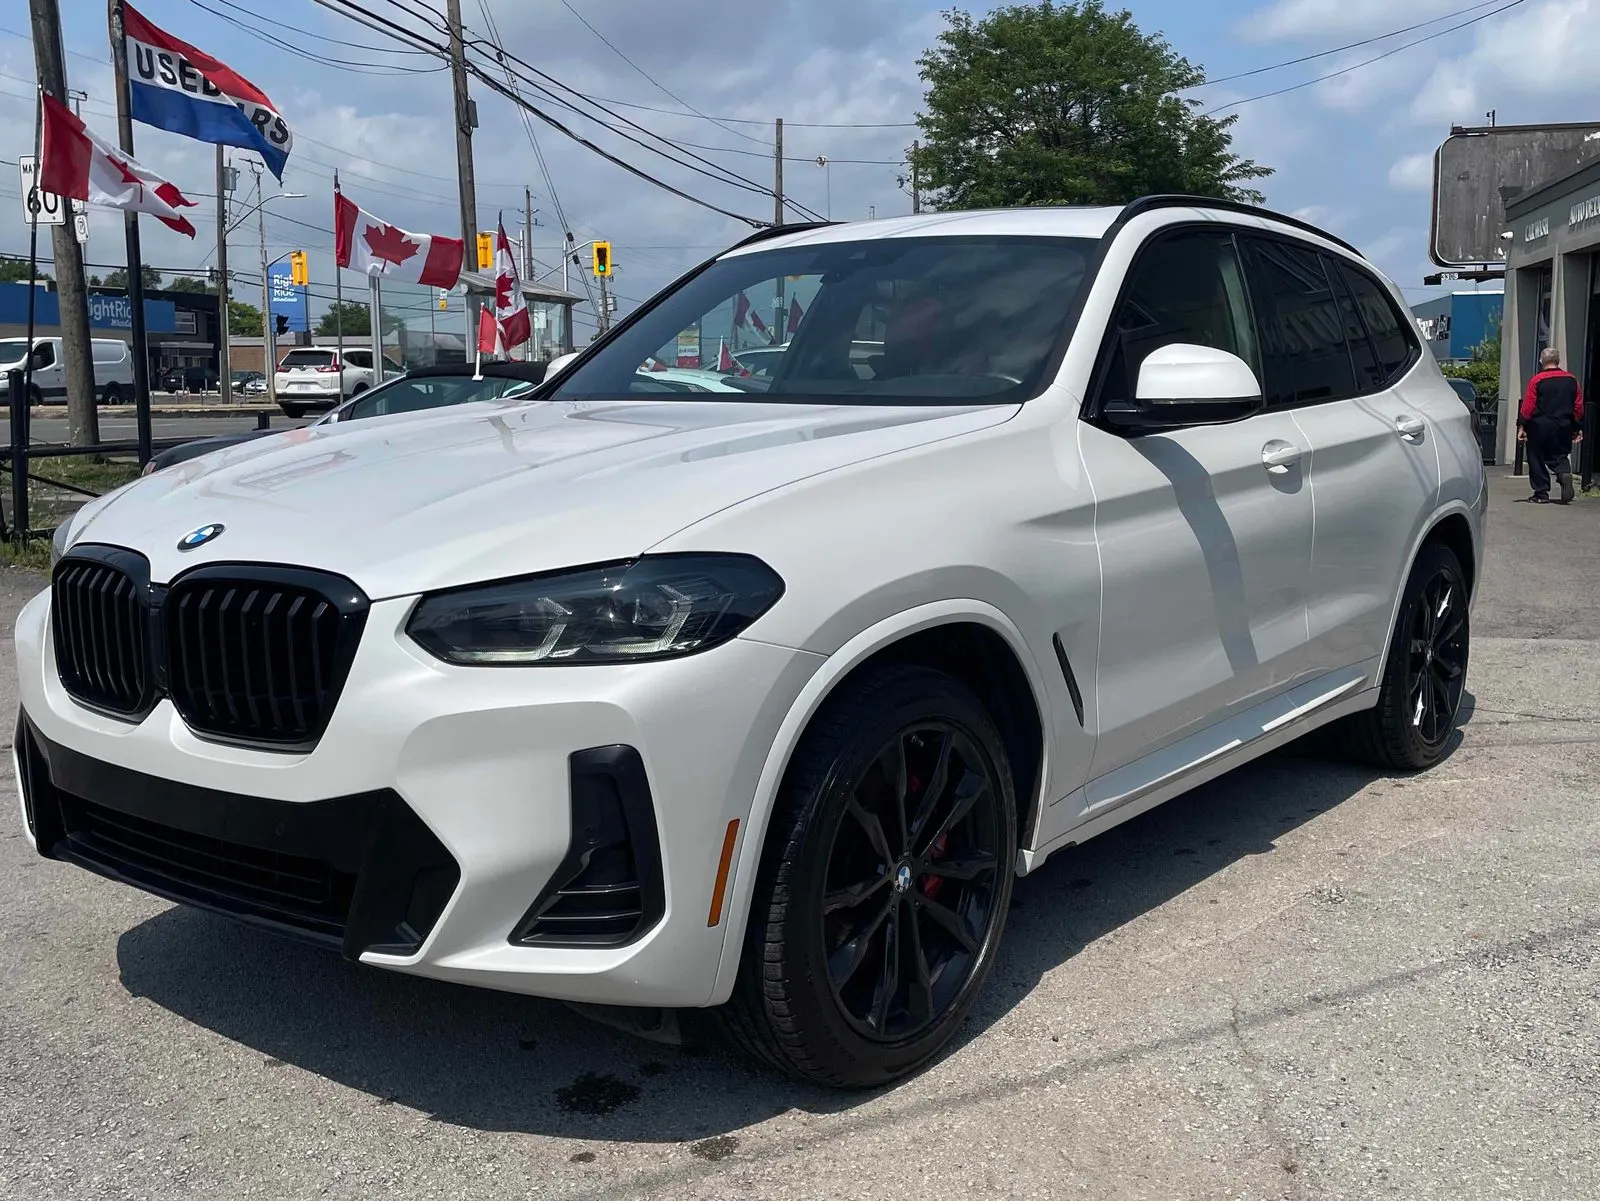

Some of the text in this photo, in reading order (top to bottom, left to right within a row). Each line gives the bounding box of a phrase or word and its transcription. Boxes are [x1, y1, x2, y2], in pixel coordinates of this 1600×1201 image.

[27, 185, 58, 215] 60
[273, 274, 294, 287] Righ
[273, 285, 295, 297] Ride
